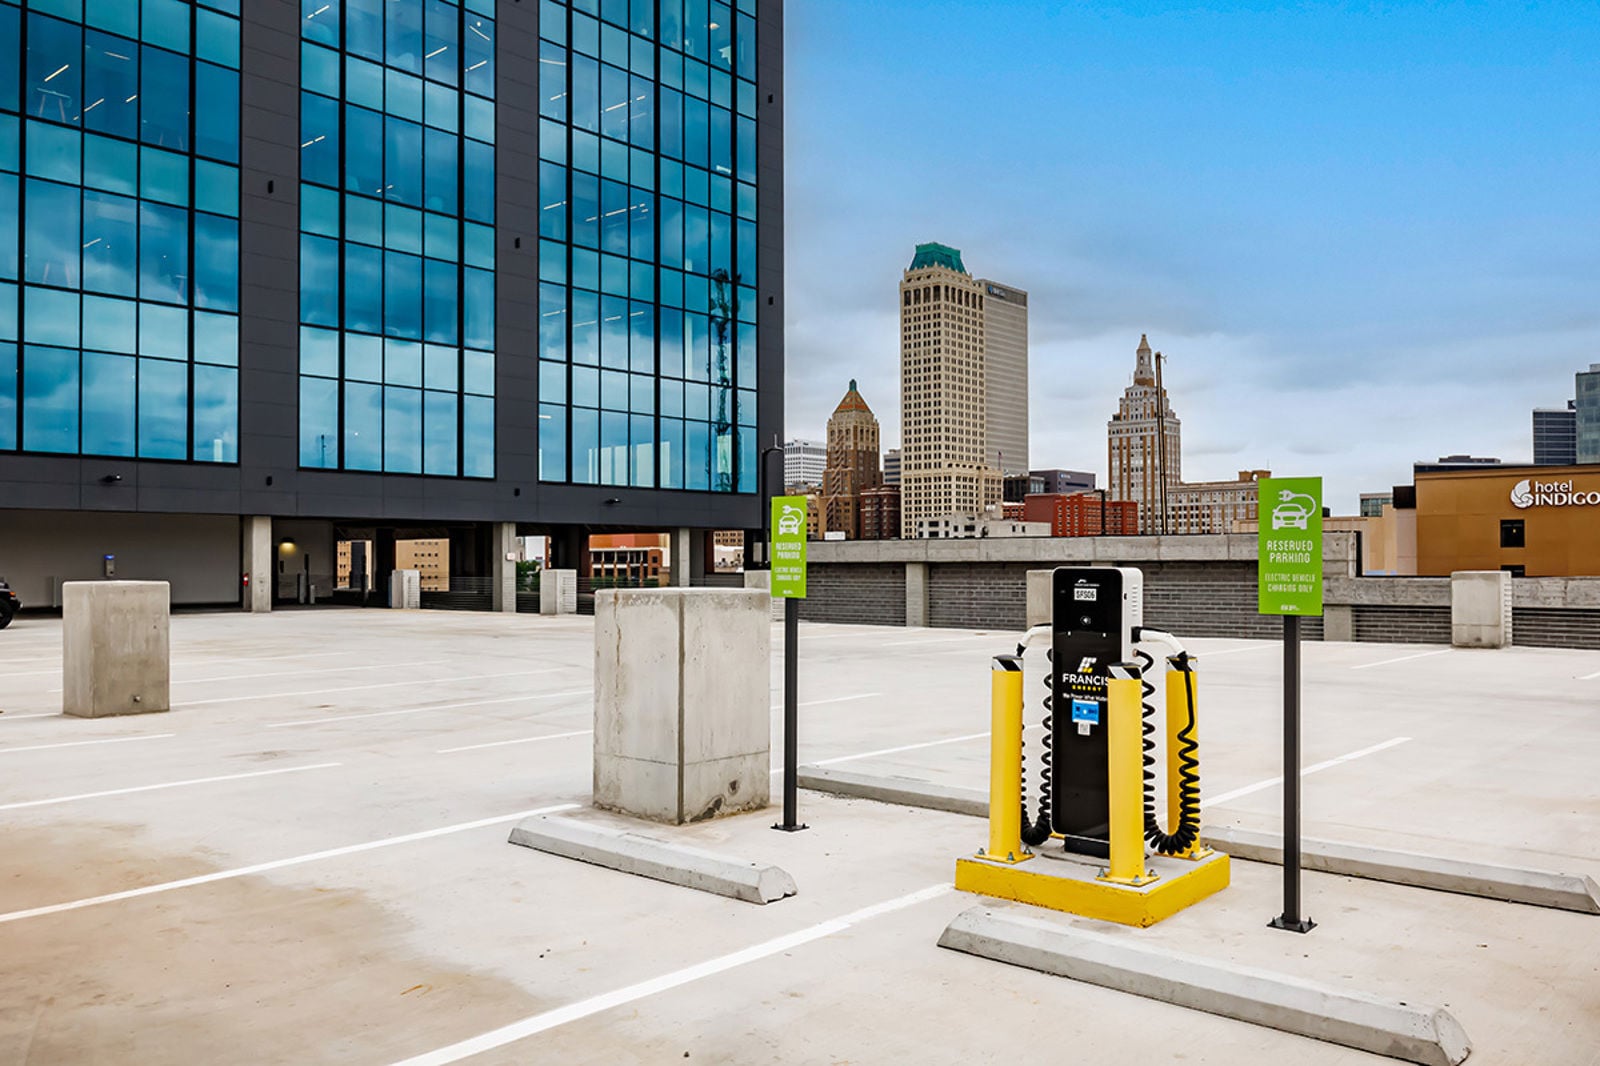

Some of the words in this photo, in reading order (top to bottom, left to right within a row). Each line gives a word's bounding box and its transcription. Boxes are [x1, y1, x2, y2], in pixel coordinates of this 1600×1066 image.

[1535, 480, 1572, 493] hotel
[1535, 491, 1600, 506] INDIGO
[1266, 540, 1313, 551] RESERVED
[1270, 552, 1310, 563] PARKING
[1062, 673, 1108, 686] FRANCIS
